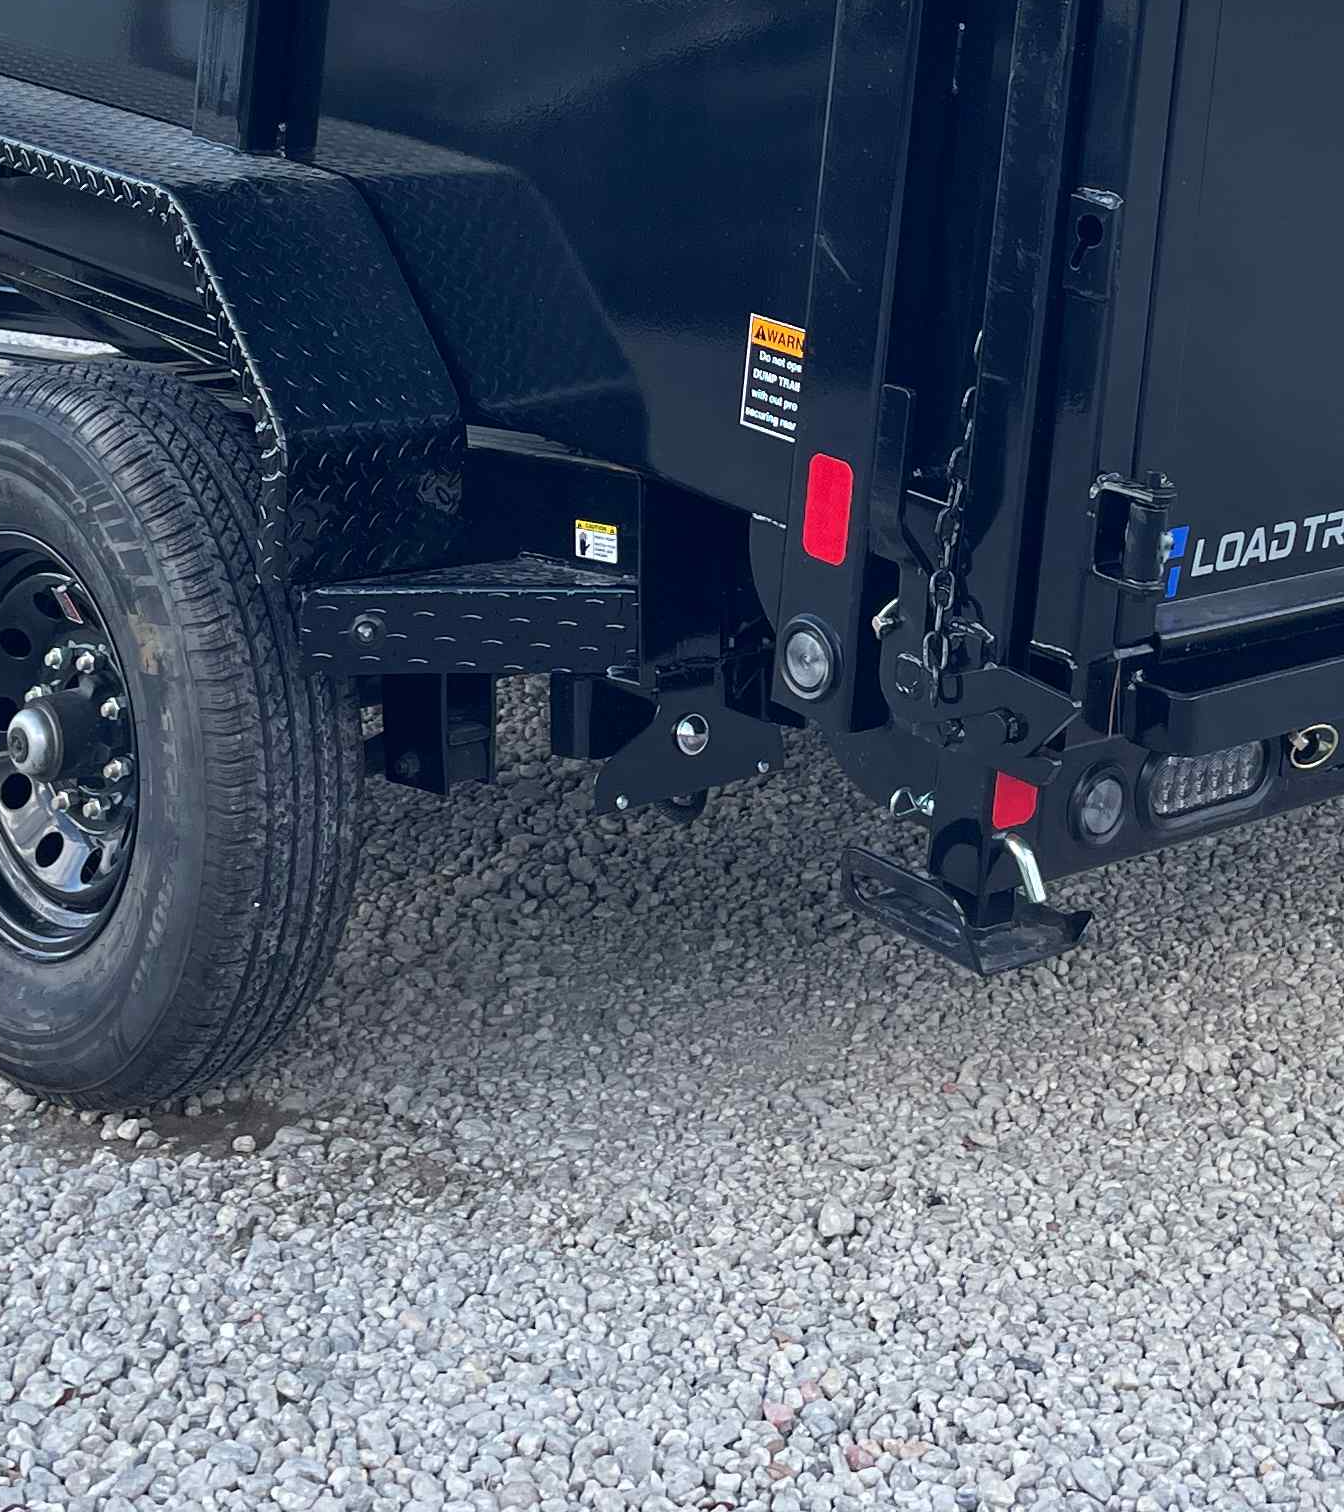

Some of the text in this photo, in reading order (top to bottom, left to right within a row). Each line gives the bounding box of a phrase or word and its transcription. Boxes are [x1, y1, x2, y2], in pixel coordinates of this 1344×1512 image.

[767, 328, 805, 349] WARN
[759, 350, 802, 374] Do not ope
[752, 367, 801, 392] DUMP TRAI
[783, 399, 798, 412] pro
[1191, 521, 1297, 577] LOAD
